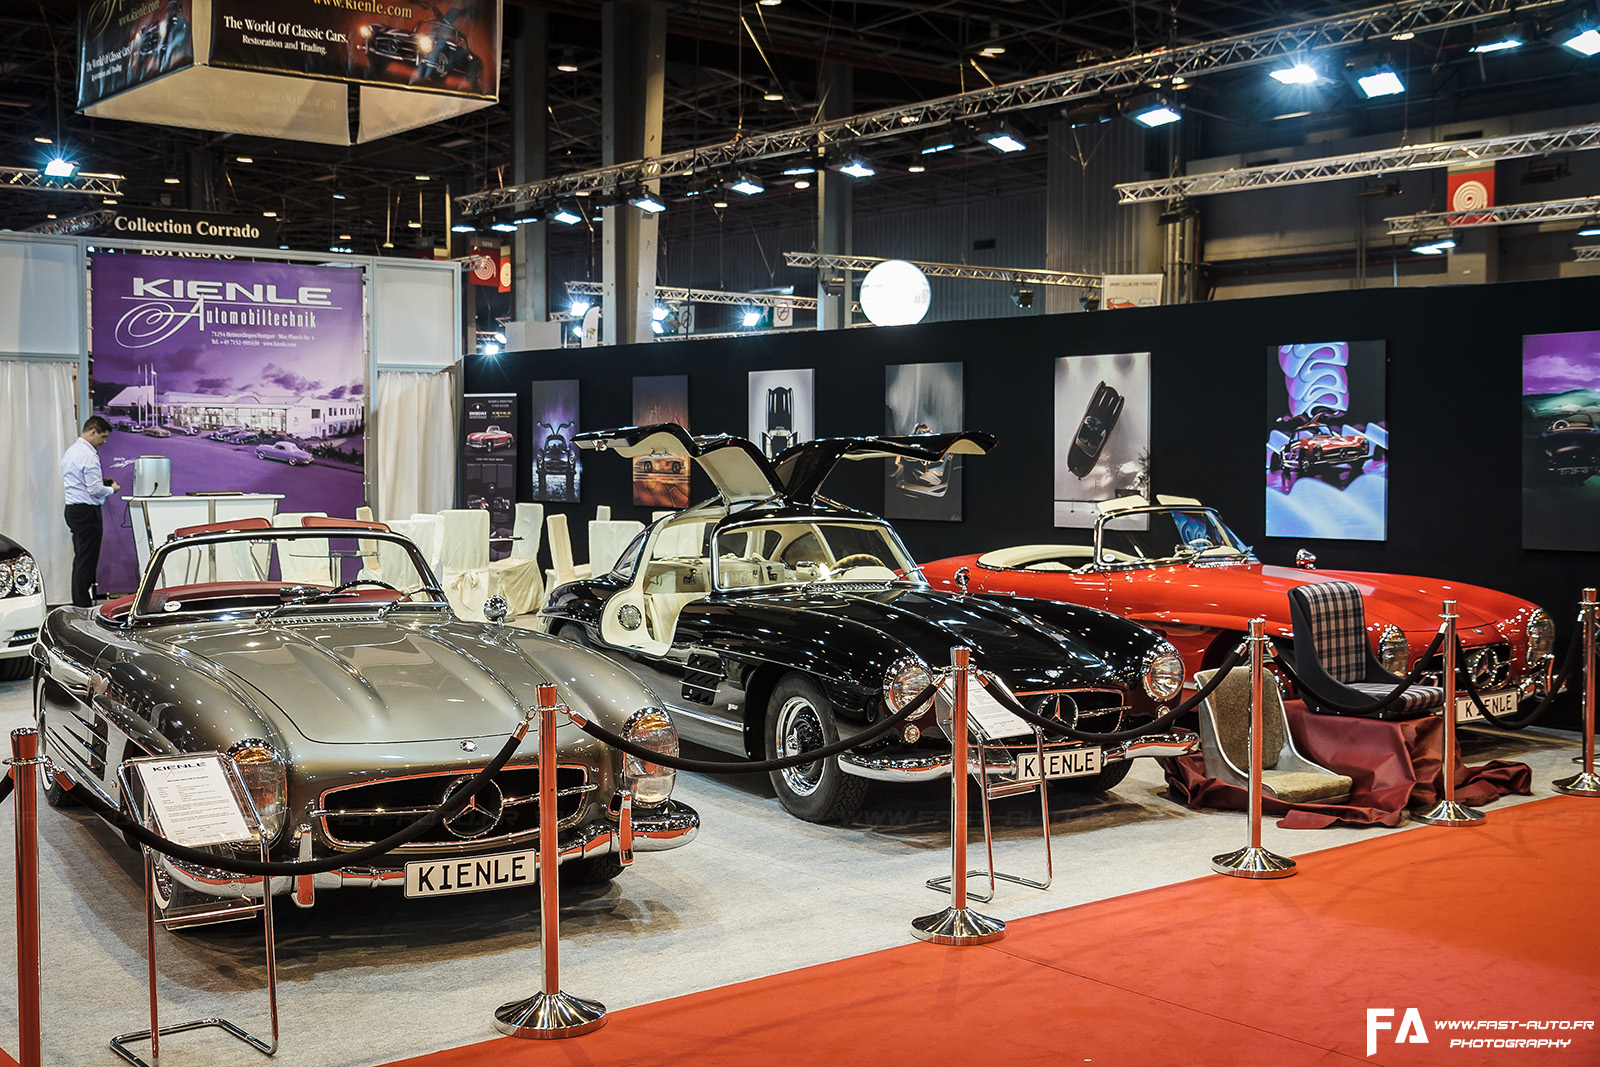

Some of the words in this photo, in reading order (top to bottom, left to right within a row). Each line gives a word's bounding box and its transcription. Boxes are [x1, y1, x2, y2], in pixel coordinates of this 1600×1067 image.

[223, 15, 243, 30] The
[244, 18, 276, 34] World
[277, 22, 291, 36] Of
[291, 24, 325, 40] Classic
[242, 34, 283, 49] Restoration
[284, 40, 299, 51] and
[114, 216, 193, 235] Collection
[196, 220, 260, 239] Corrado
[133, 277, 332, 306] KIENLE
[153, 762, 206, 771] KIENLE
[1024, 751, 1095, 777] KENLE
[418, 856, 526, 892] KIENLE
